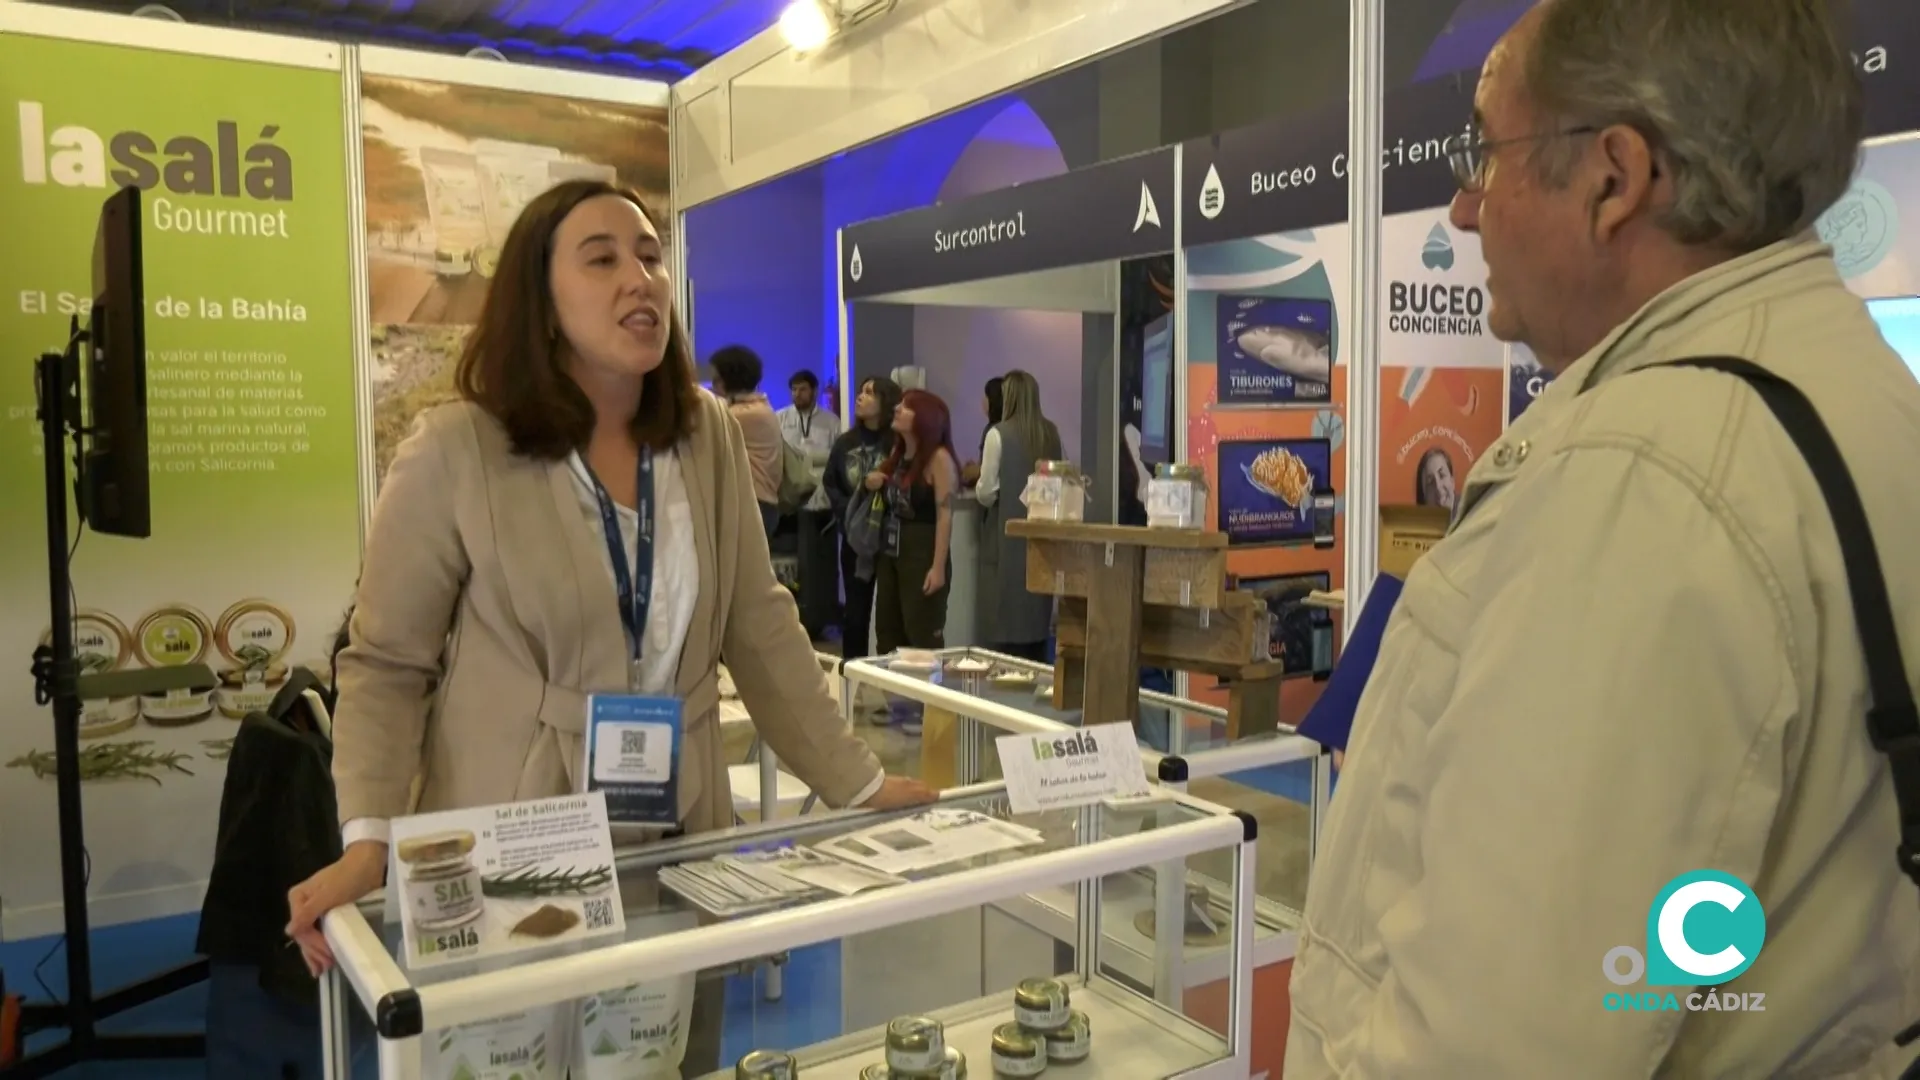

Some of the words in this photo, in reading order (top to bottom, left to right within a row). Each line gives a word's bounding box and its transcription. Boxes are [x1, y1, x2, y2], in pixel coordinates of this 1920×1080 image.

[19, 100, 293, 201] lasalá
[1251, 164, 1316, 195] Buceo
[153, 198, 288, 239] Gourmet
[935, 211, 1026, 253] Surcontrol
[20, 290, 46, 314] El
[155, 296, 190, 318] de
[200, 297, 223, 319] la
[233, 298, 307, 321] Bahía
[1390, 281, 1483, 316] BUCEO
[1389, 314, 1483, 336] CONCIENCIA
[160, 349, 199, 363] valor
[222, 350, 287, 365] territorio
[215, 368, 285, 382] mediante
[1230, 375, 1292, 388] TIBURONES
[285, 406, 326, 418] como
[1031, 731, 1098, 760] lasalá
[495, 808, 512, 819] Sal
[515, 806, 528, 817] de
[532, 799, 588, 815] Salicornia
[434, 878, 474, 903] SAL
